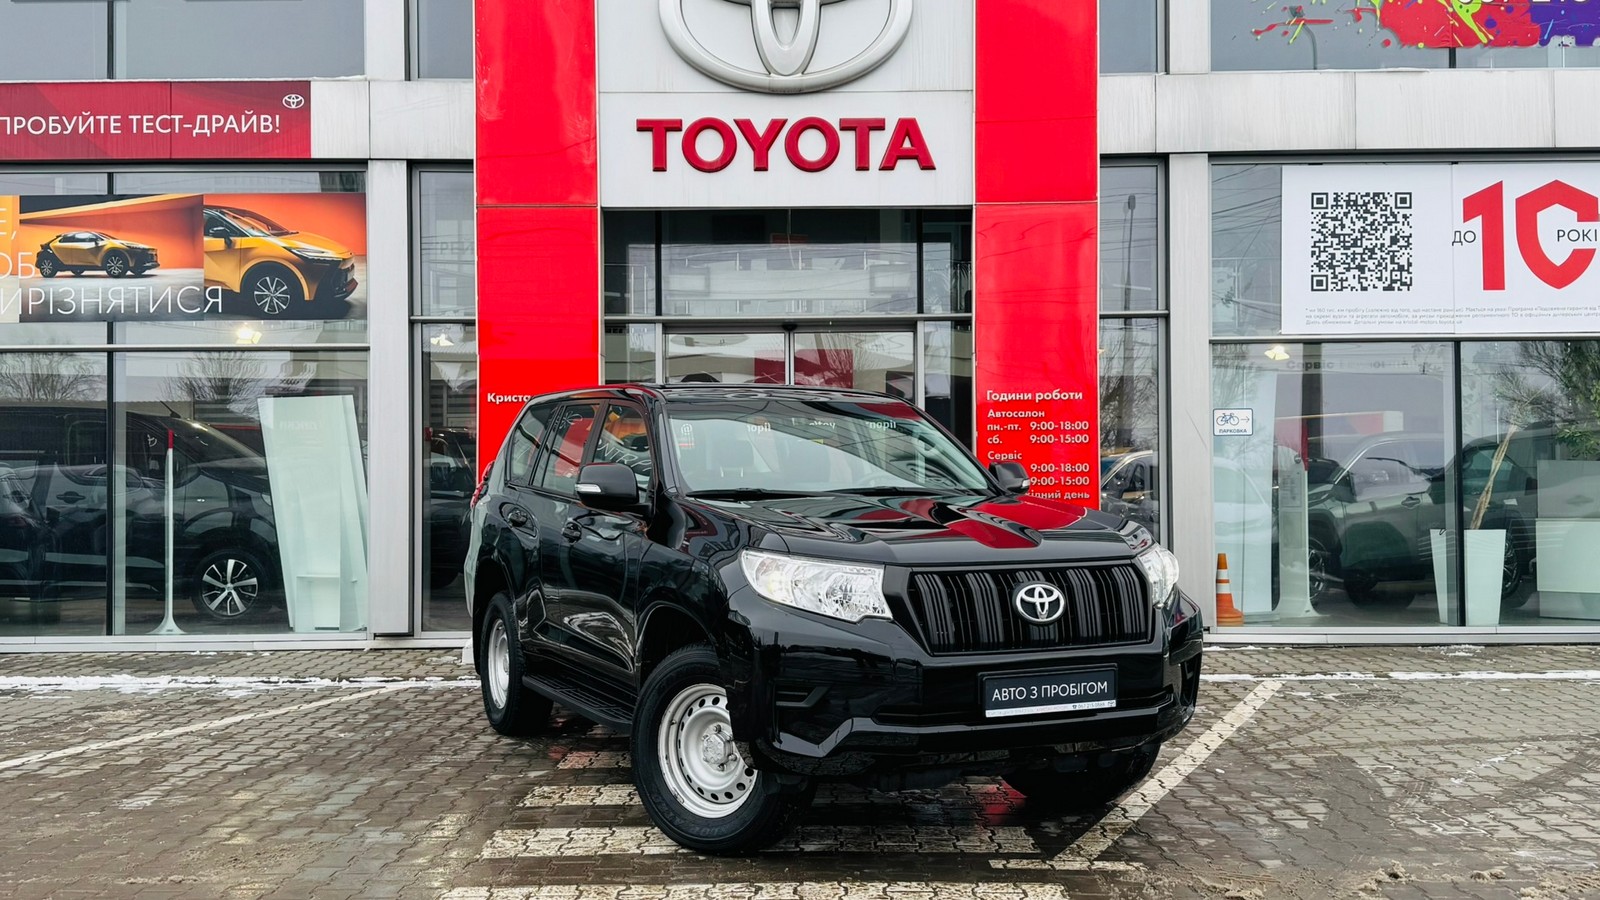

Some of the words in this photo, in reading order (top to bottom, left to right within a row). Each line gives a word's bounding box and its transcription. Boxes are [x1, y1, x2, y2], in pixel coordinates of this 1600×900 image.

[129, 112, 280, 137] ТЕСТ-ДРАЙВ!
[636, 117, 936, 172] TOYOTA
[1452, 230, 1477, 246] ДО
[1557, 229, 1598, 242] РОКІ
[1, 286, 223, 314] ИРІЗНЯТИСЯ
[487, 393, 532, 404] Криста
[986, 390, 1032, 402] Години
[1036, 389, 1083, 402] роботи
[987, 409, 1045, 418] Автосалон
[987, 423, 1021, 431] пн.-пт.
[1030, 421, 1089, 430] 9:00-18:00
[987, 434, 1002, 444] сб.
[1030, 434, 1089, 444] 9:00-15:00
[987, 450, 1022, 460] Сервіс
[1030, 463, 1089, 472] 9:00-18:00
[1030, 476, 1089, 485] 9:00-15:00
[1064, 491, 1090, 500] день
[991, 687, 1026, 702] АВТО
[1041, 681, 1108, 698] ПРОБІГОМ
